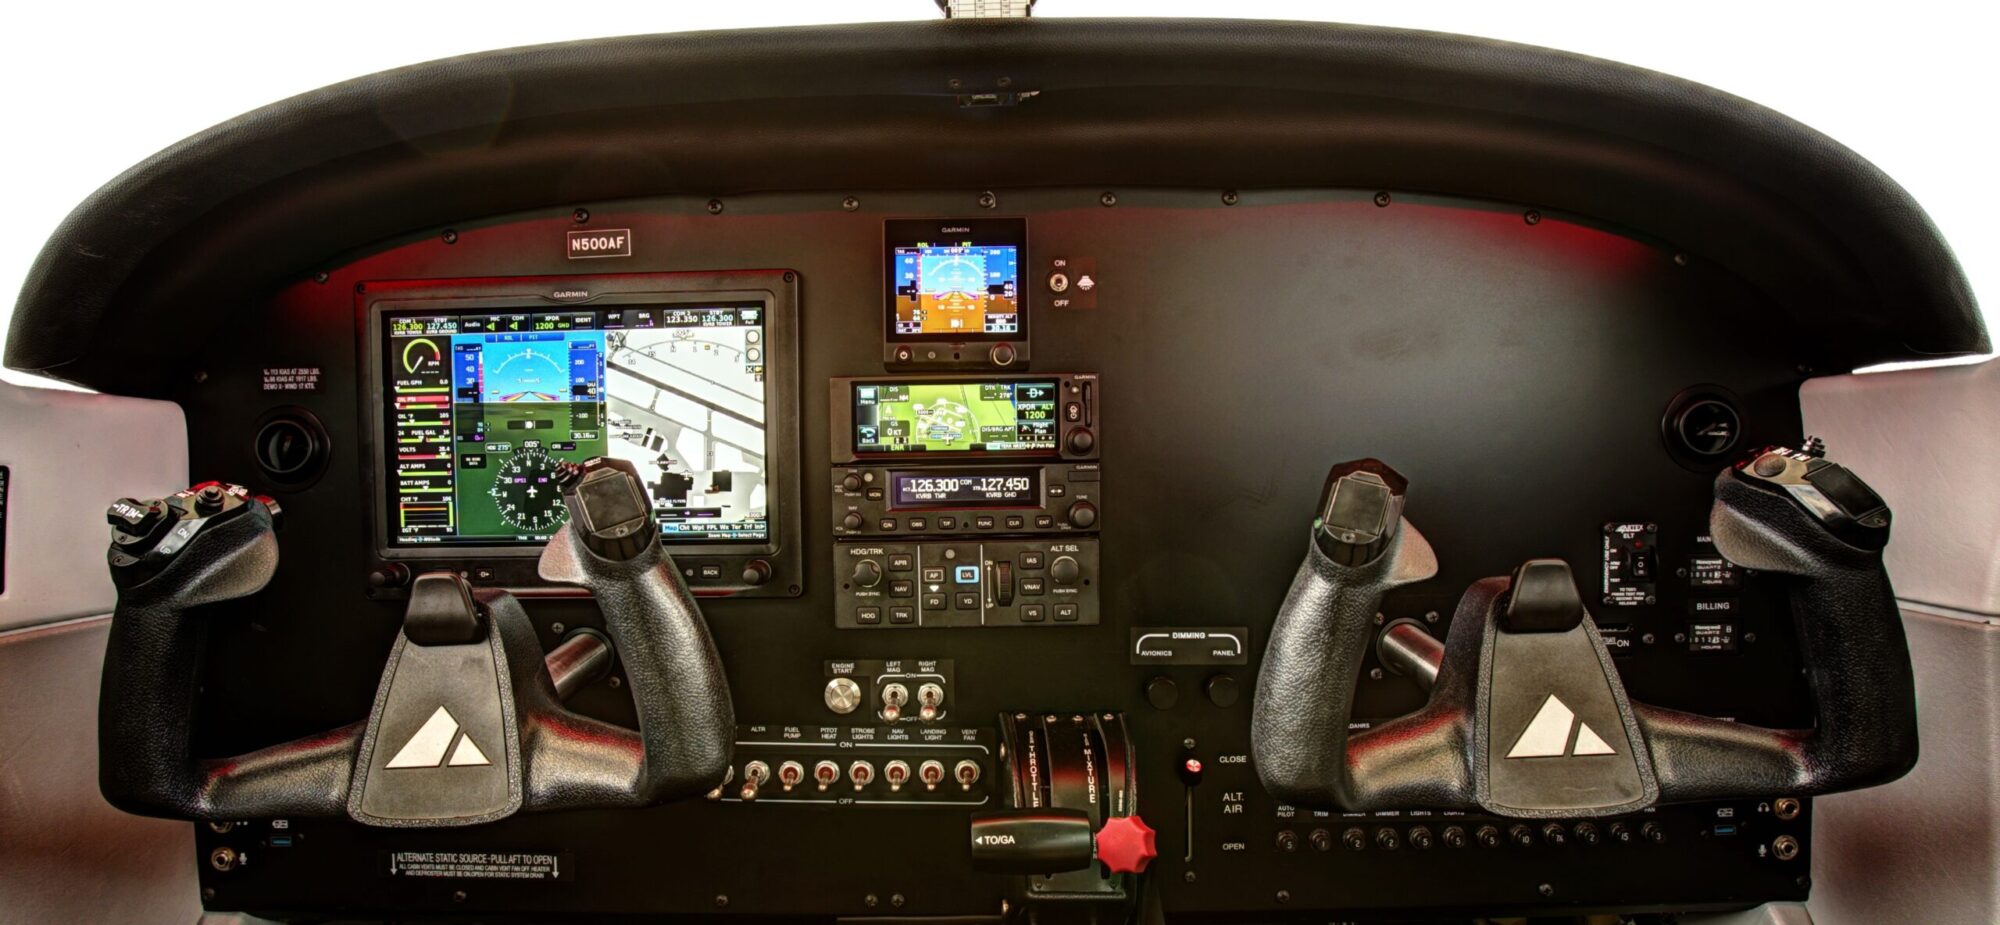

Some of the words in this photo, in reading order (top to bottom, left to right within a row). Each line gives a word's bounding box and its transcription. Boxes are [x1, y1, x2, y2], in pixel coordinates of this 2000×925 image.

[572, 236, 624, 251] N500AF
[666, 315, 698, 323] 123.350
[393, 323, 423, 331] 126.300
[426, 322, 457, 330] 127.450
[1025, 411, 1046, 419] 1200
[910, 479, 959, 492] 126.300
[981, 478, 1029, 491] 127.450
[177, 528, 190, 538] DN
[159, 546, 171, 555] UP
[1696, 602, 1730, 610] BILLING
[1616, 639, 1630, 647] ON
[1219, 755, 1247, 763] CLOSE
[1083, 749, 1096, 803] MIXTURE
[1222, 792, 1244, 801] ALT.
[1223, 804, 1243, 813] AIR
[984, 835, 1016, 845] TO/GA
[397, 852, 434, 862] ALTERNATE
[435, 853, 458, 863] STATIC
[508, 854, 521, 864] AFT
[522, 854, 532, 864] TO
[533, 855, 552, 865] OPEN
